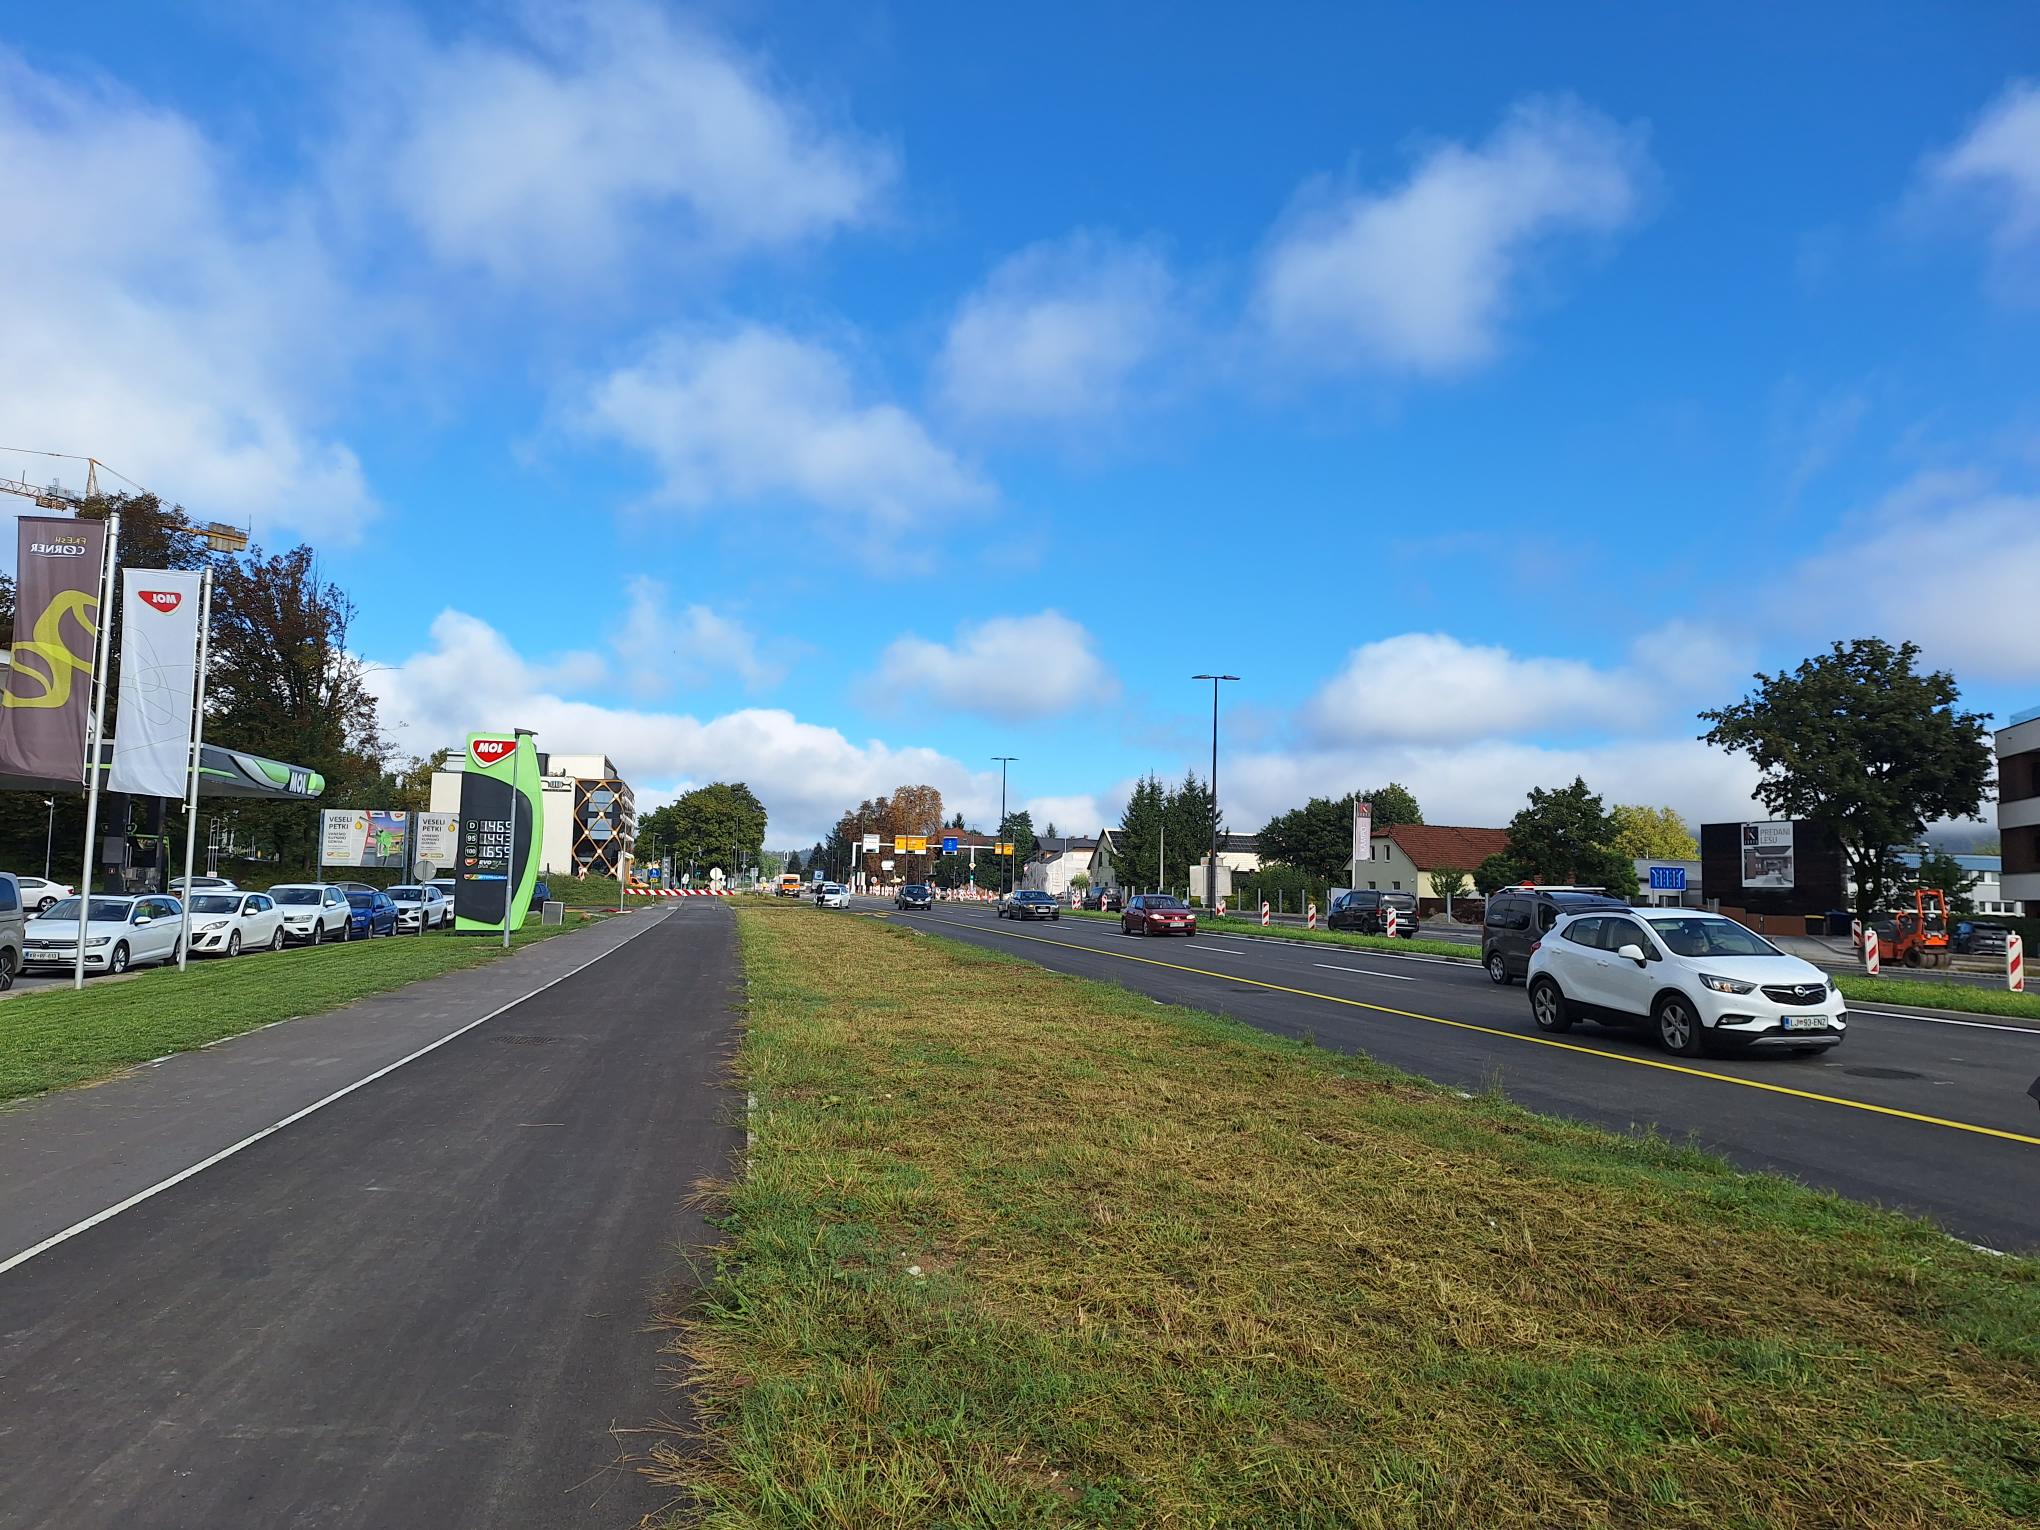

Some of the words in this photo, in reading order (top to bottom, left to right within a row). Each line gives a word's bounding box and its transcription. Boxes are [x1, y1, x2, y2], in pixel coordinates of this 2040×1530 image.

[477, 742, 504, 754] MOL
[289, 771, 307, 795] MOL
[422, 818, 446, 826] VESELI
[1760, 828, 1791, 836] PREDANI
[1760, 836, 1778, 844] LESU
